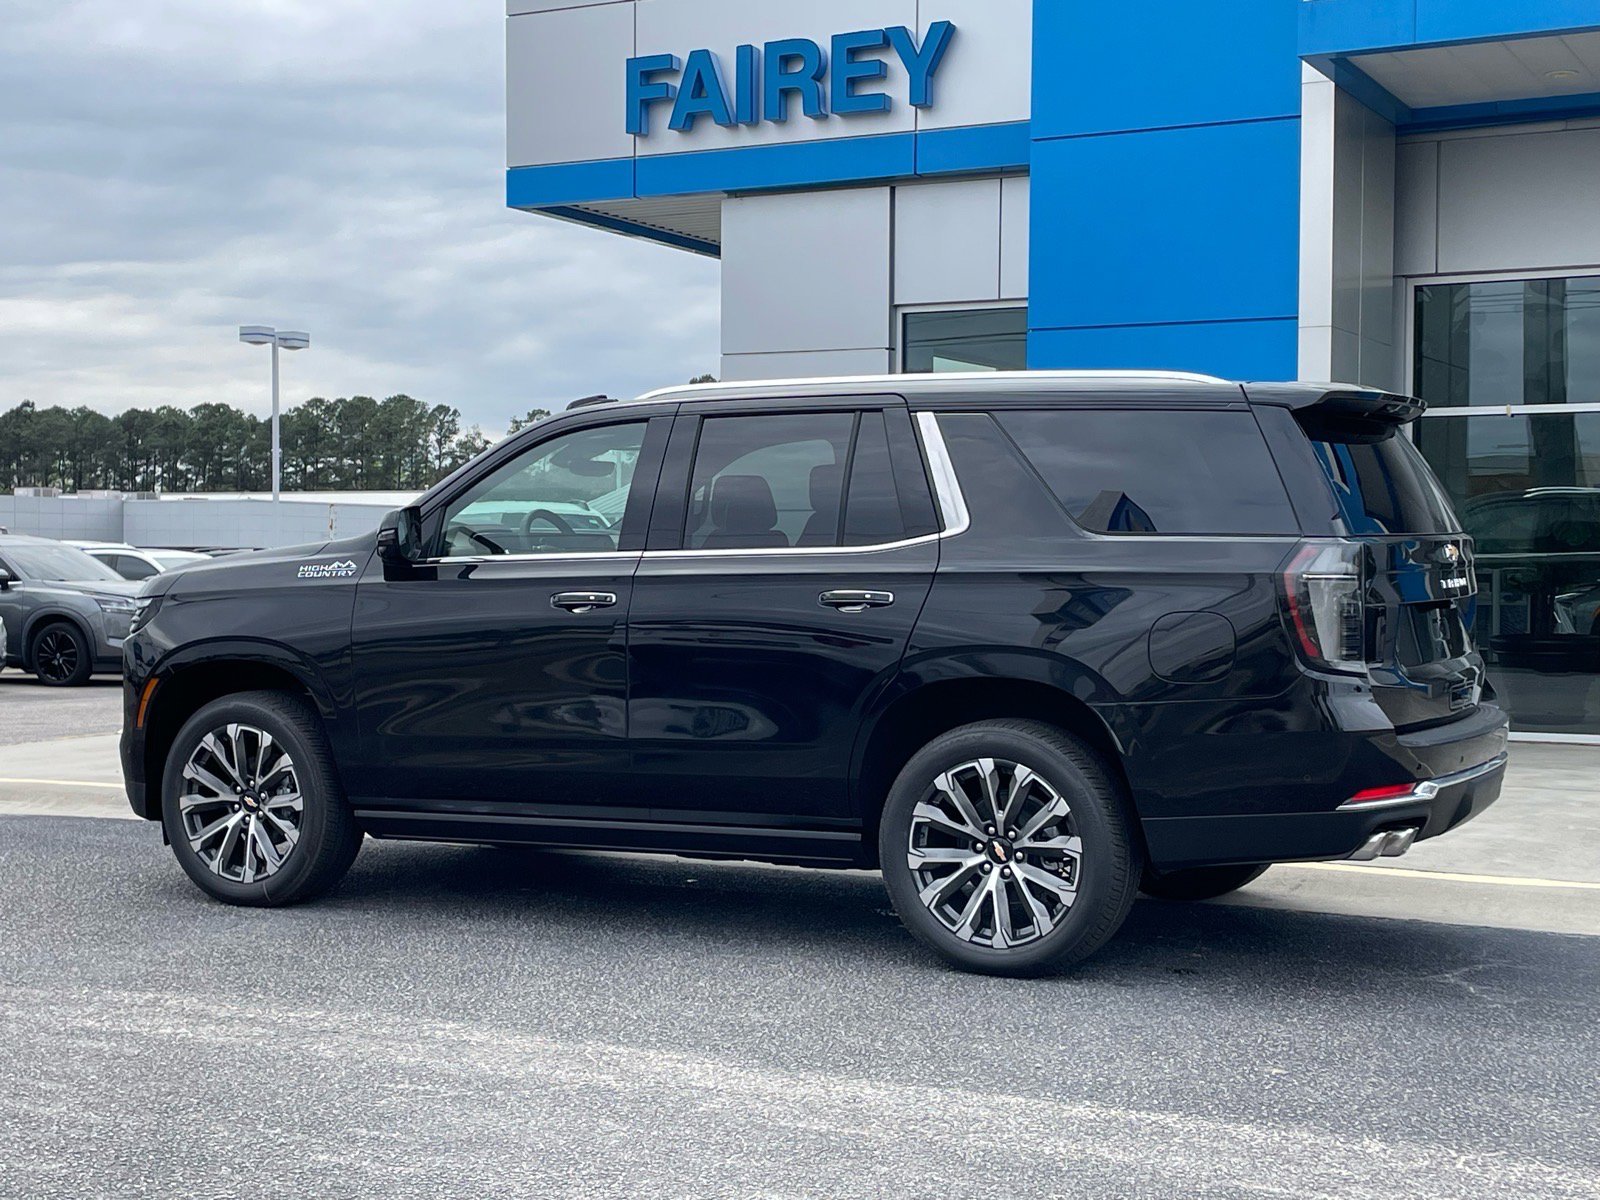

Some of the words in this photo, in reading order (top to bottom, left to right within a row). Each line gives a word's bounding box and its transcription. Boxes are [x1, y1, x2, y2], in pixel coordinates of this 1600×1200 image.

[626, 20, 956, 137] FAIREY
[299, 564, 329, 572] HIGH
[297, 570, 356, 578] COUNTRY
